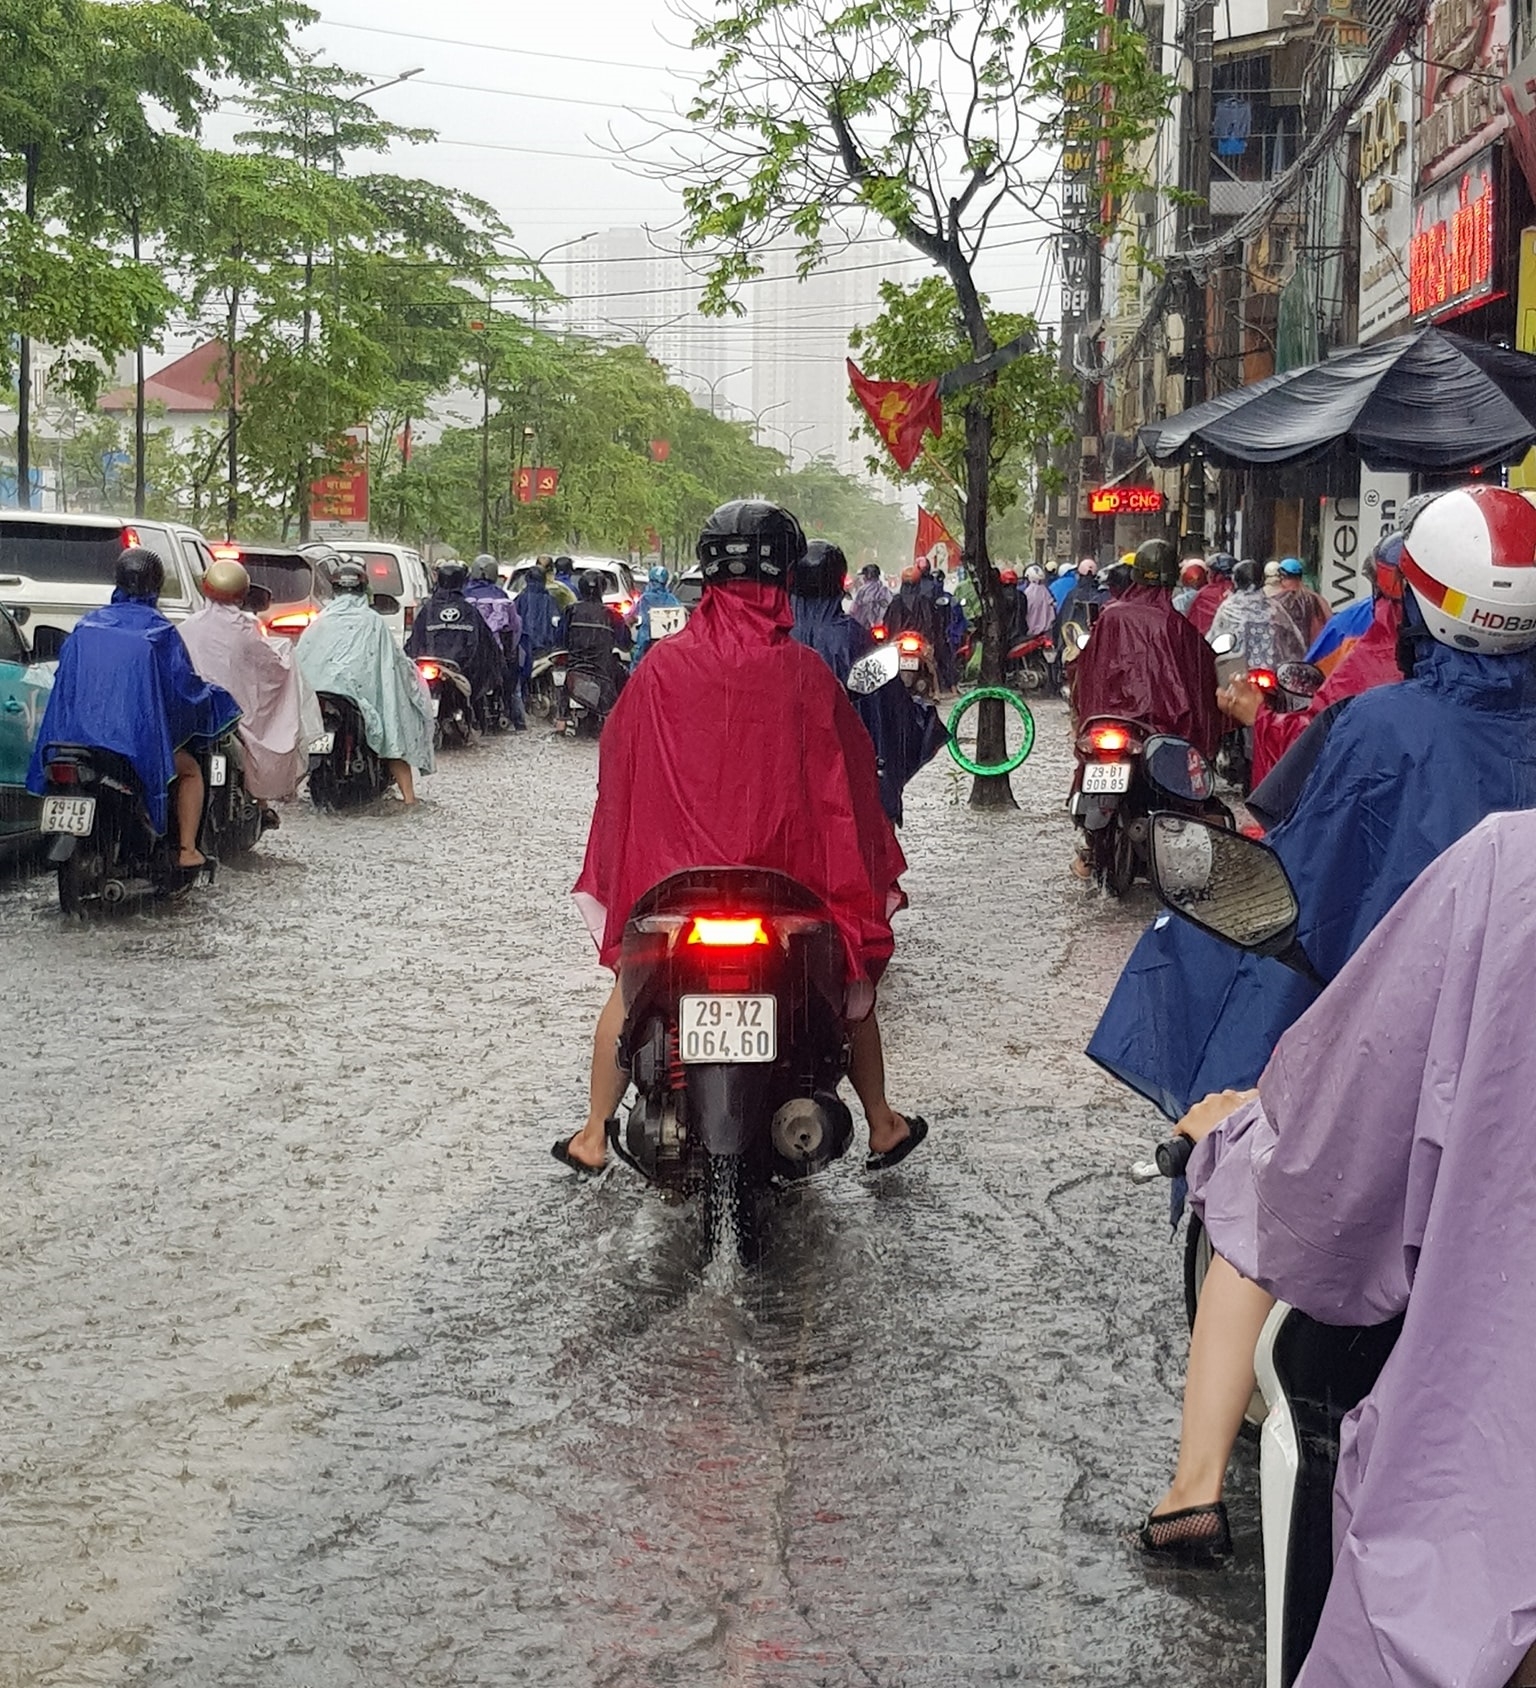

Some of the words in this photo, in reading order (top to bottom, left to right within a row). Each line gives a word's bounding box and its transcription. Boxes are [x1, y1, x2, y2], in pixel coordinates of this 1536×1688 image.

[51, 801, 88, 816] 29-L6
[48, 816, 85, 831] 9445
[696, 1000, 762, 1027] 29-X2
[687, 1030, 769, 1057] 064.60
